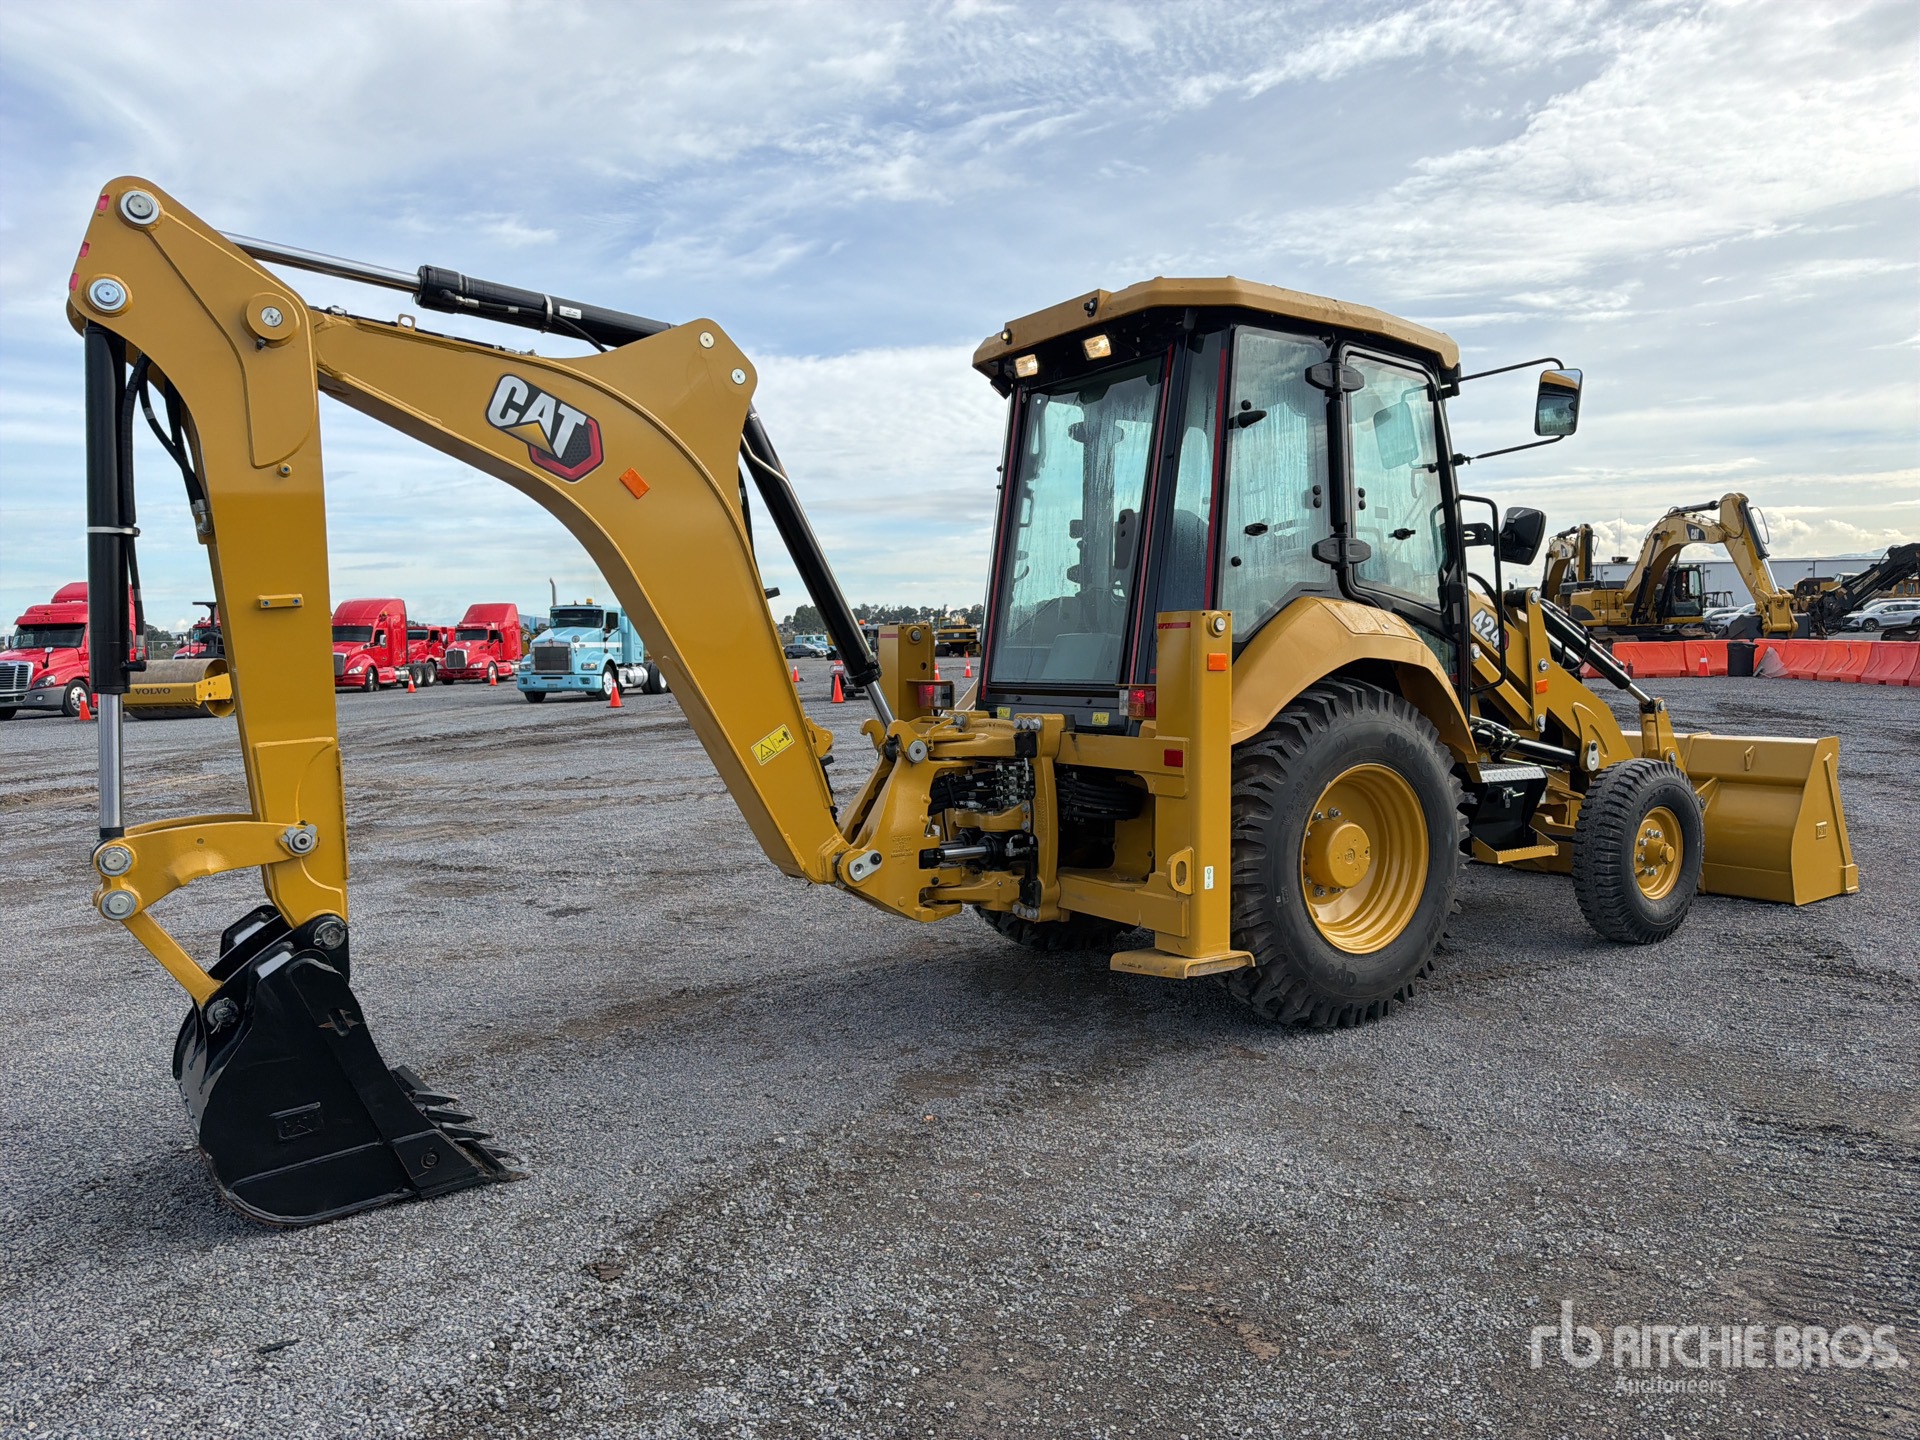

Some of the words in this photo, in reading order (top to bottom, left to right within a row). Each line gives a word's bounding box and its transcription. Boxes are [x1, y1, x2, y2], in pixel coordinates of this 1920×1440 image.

[487, 375, 589, 460] CAT
[1690, 528, 1701, 540] CAT
[135, 687, 171, 695] VOLVO
